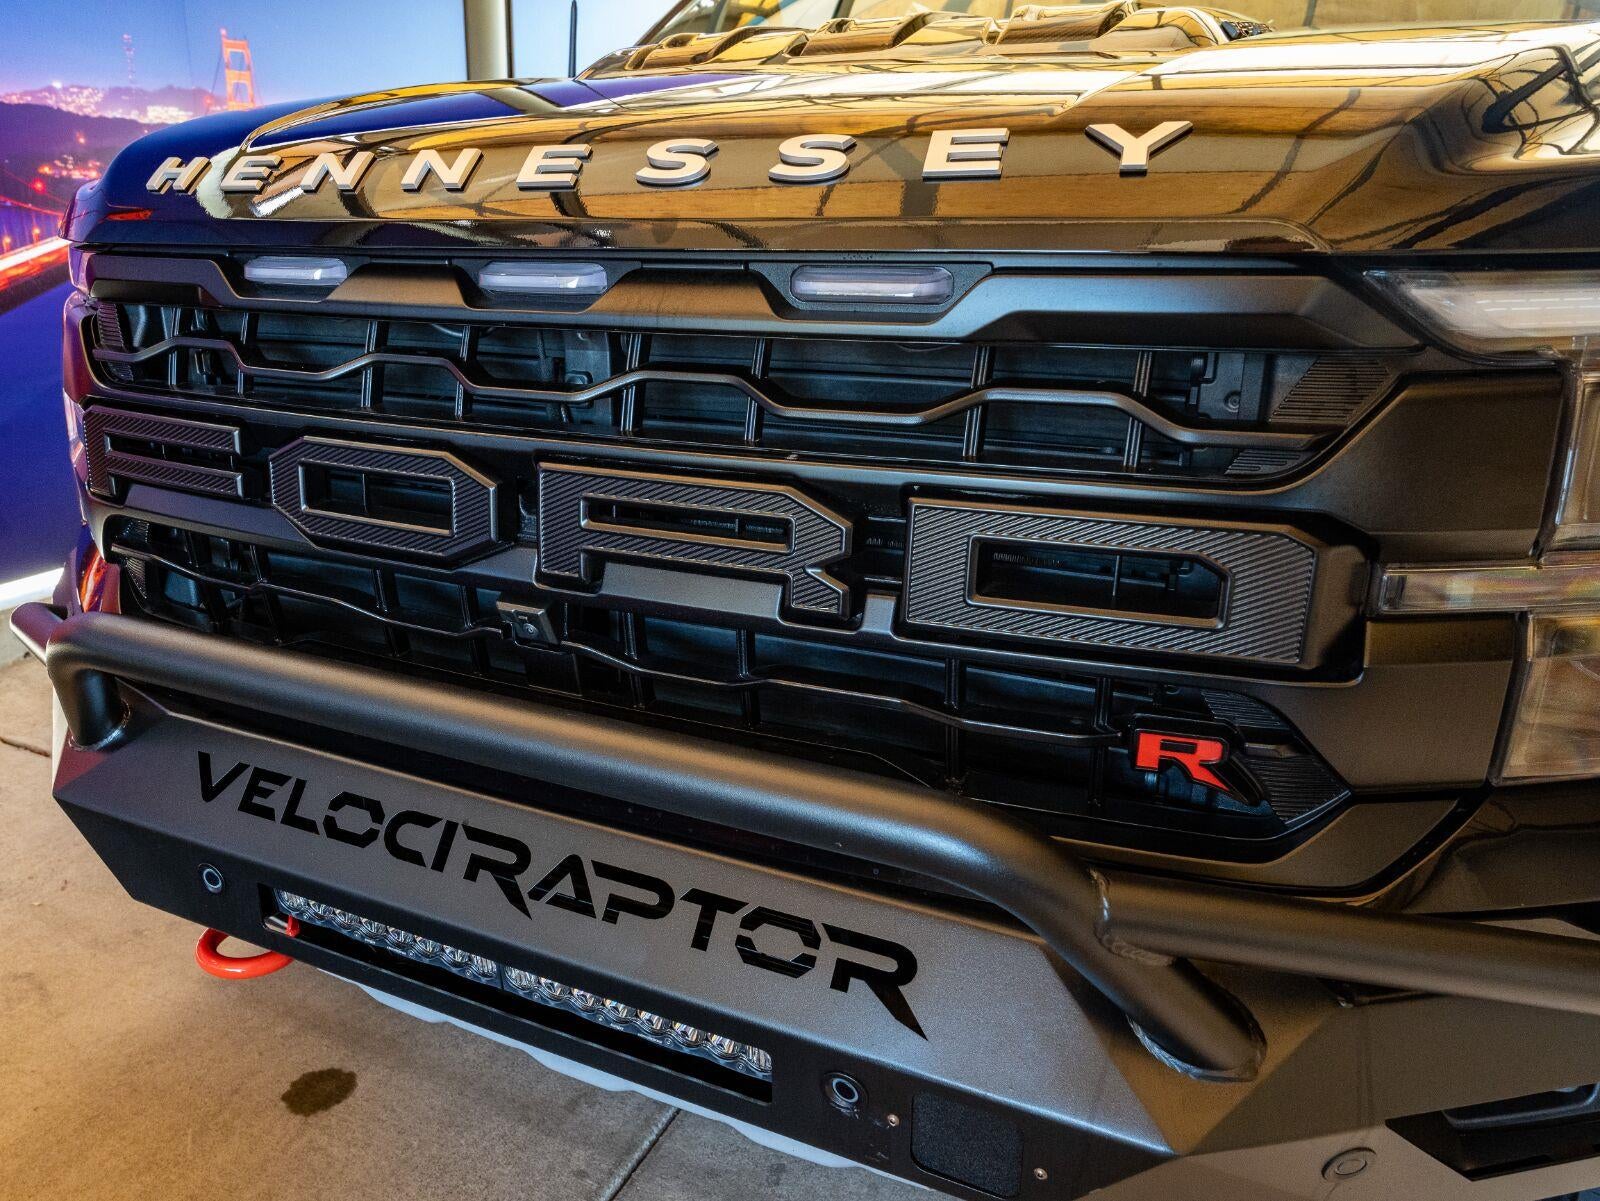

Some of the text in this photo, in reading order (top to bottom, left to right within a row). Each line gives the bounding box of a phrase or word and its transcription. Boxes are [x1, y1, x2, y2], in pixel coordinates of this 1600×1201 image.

[146, 120, 1193, 195] HENNESSEY
[84, 404, 1318, 668] FORD
[1136, 731, 1230, 791] R
[197, 751, 929, 1041] VELOCIRAPTOR
